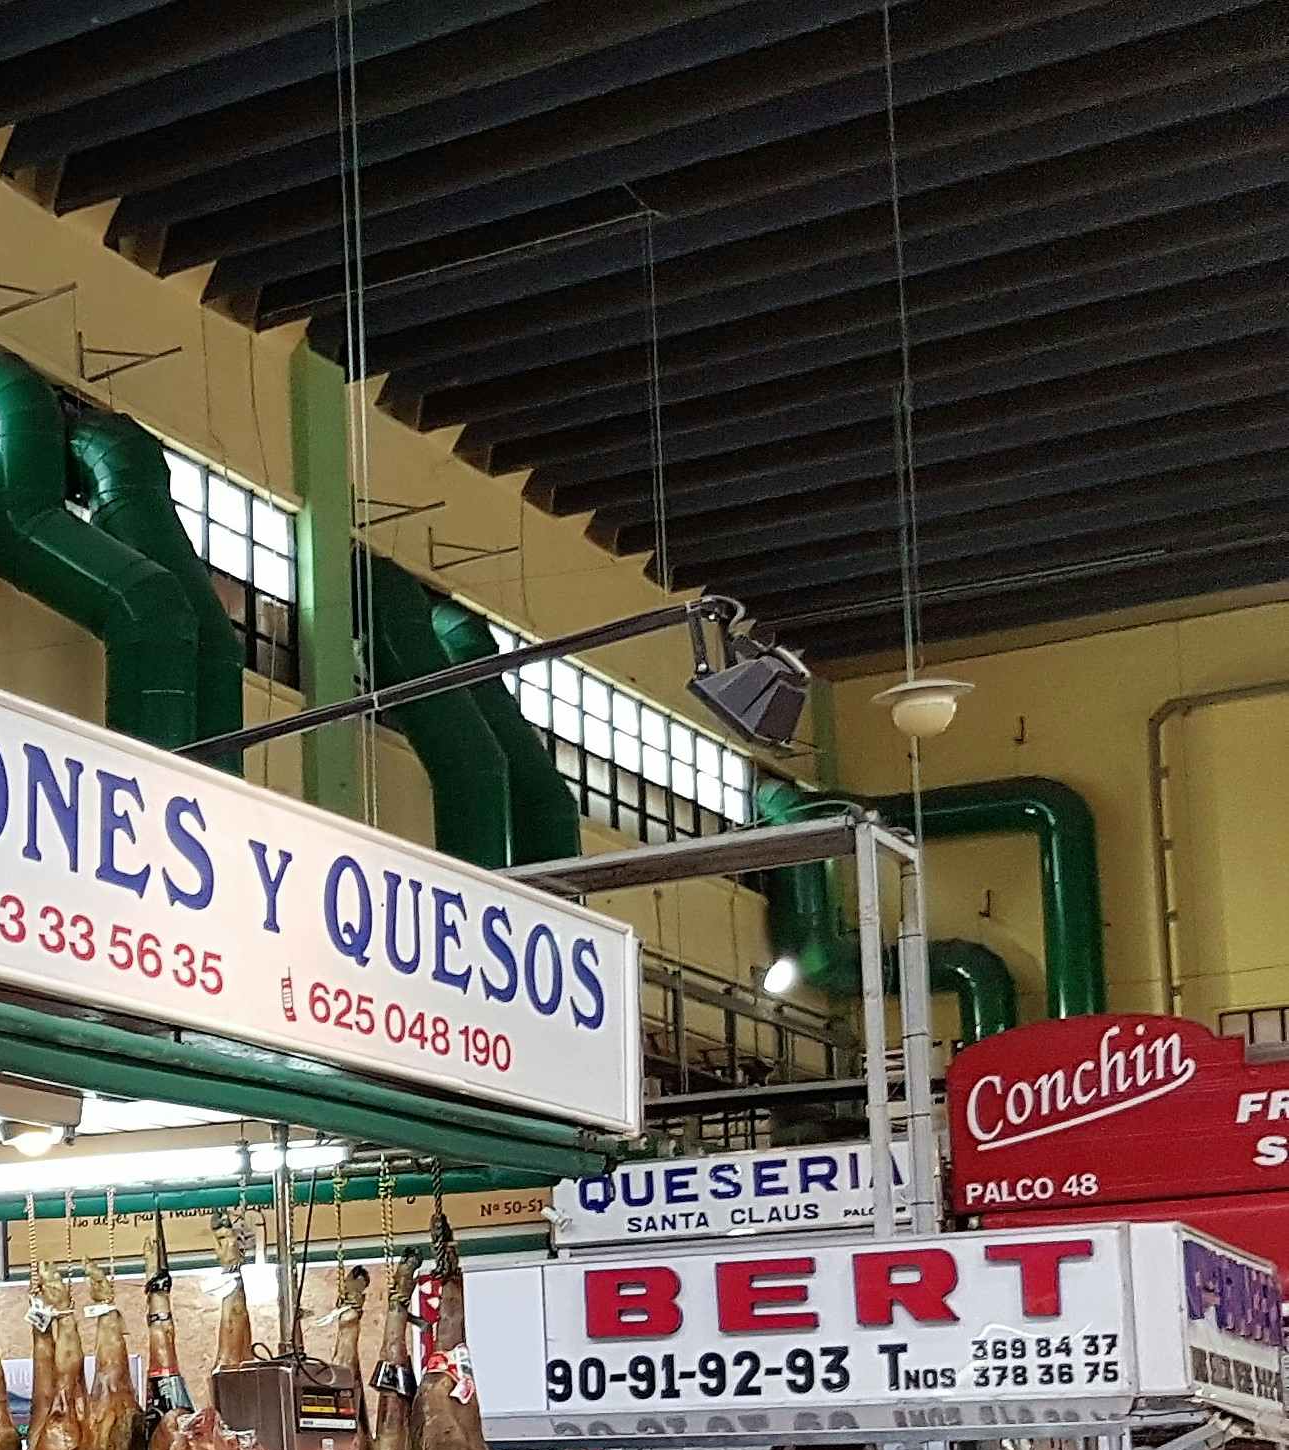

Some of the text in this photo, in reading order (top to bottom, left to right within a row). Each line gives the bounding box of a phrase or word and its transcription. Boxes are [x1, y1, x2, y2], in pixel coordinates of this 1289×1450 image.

[38, 904, 96, 962] 33
[107, 924, 165, 980] 56
[170, 941, 225, 997] 35
[247, 838, 294, 932] Y
[324, 854, 606, 1031] QUESOS
[309, 980, 514, 1074] 625 048 190
[966, 1024, 1197, 1142] Conchin
[503, 1199, 544, 1215] 50-51
[627, 1211, 710, 1233] SANTA
[730, 1203, 820, 1226] CLAUS
[965, 1172, 1099, 1205] PALCO 48
[584, 1239, 1094, 1339] BERT
[544, 1344, 851, 1403] 90-91-92-93
[970, 1333, 1119, 1361] 369 84 37
[972, 1361, 1120, 1387] 378 36 75
